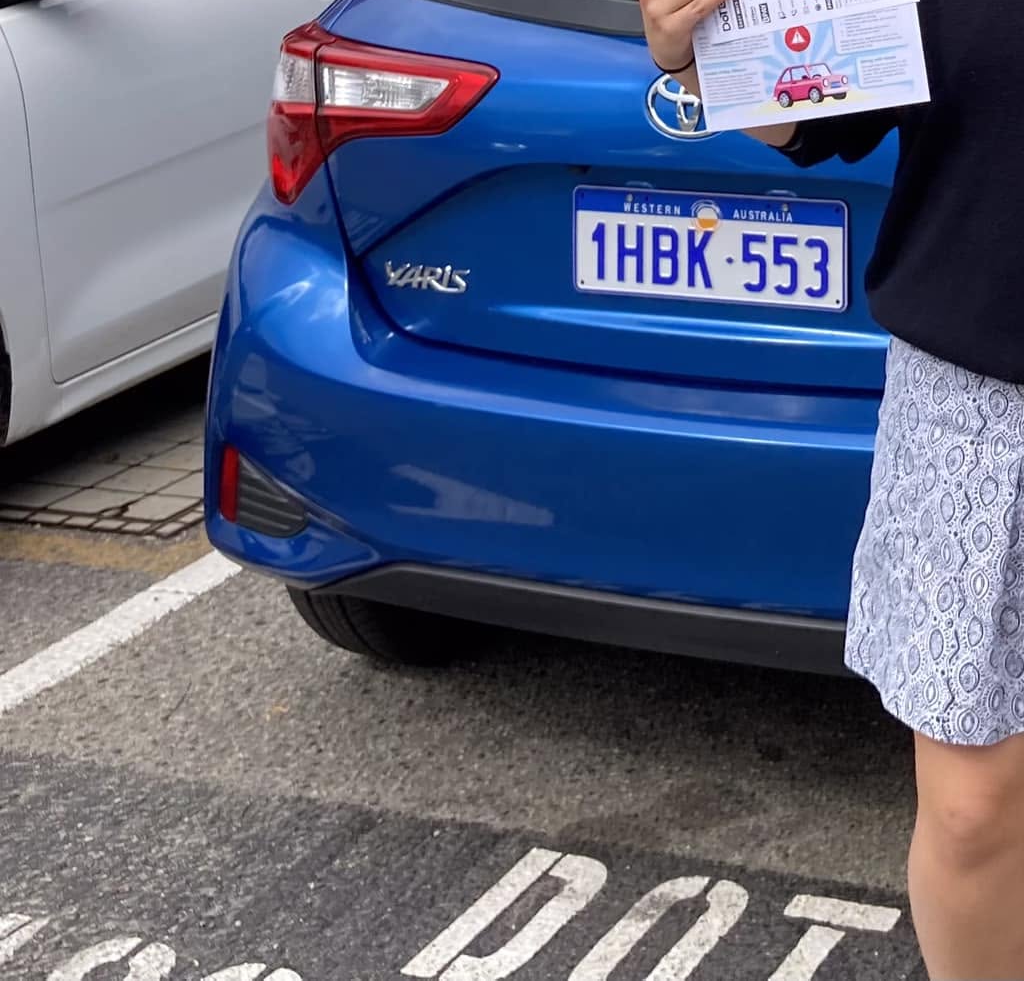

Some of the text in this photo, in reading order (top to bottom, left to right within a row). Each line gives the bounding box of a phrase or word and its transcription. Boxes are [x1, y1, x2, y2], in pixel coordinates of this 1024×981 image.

[623, 202, 793, 223] WESTERN AUSTRALIA
[385, 260, 471, 293] YARIS
